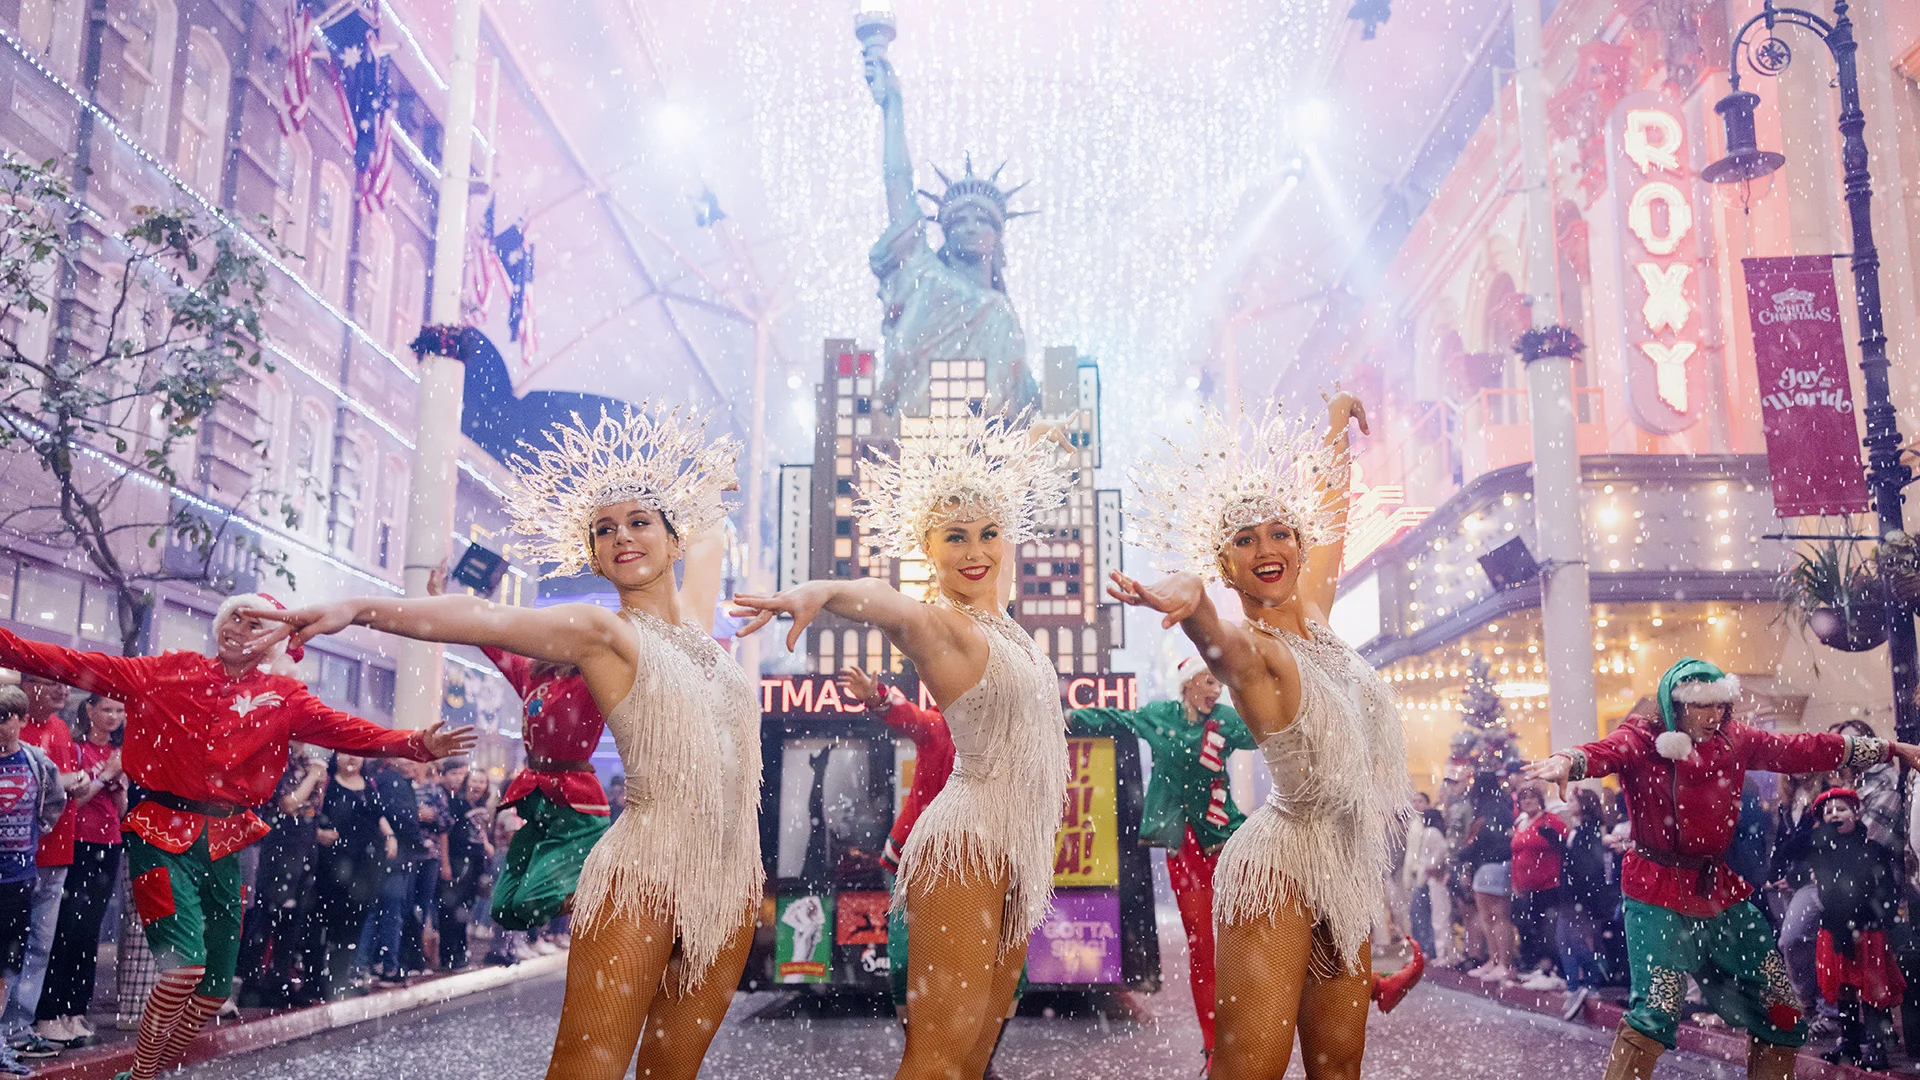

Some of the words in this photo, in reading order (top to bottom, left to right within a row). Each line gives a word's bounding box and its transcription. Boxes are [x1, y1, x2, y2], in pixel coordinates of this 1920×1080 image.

[1624, 109, 1698, 414] ROXY
[1758, 307, 1832, 325] CHRISTMAS
[1773, 303, 1814, 314] WHITE
[1778, 367, 1826, 390] Joy
[1762, 388, 1853, 415] World
[1043, 921, 1115, 939] GOTTA
